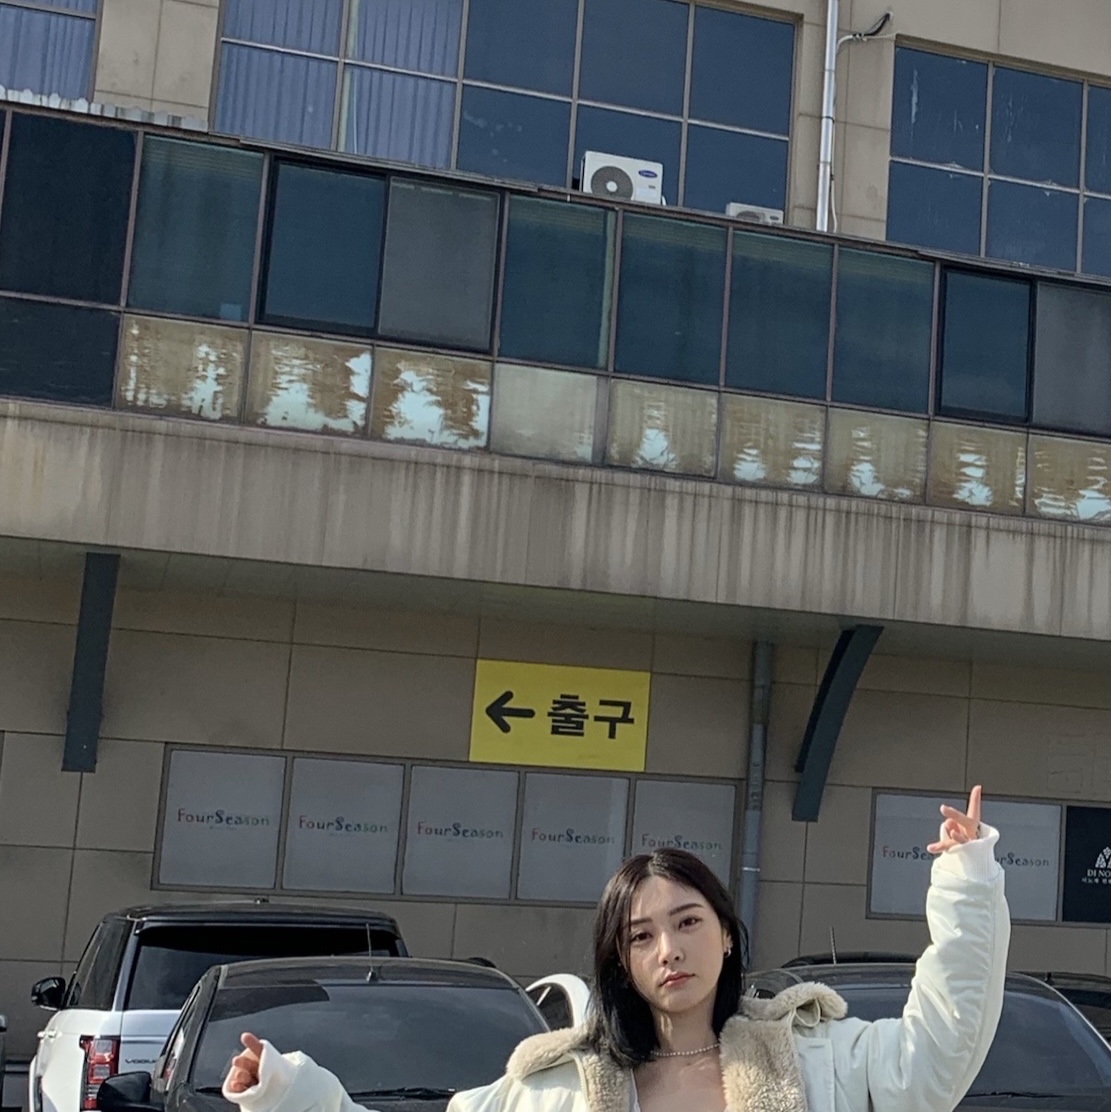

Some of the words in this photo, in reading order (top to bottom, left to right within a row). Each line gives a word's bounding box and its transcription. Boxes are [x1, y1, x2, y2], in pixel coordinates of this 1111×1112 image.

[547, 694, 635, 739] 출구
[177, 808, 270, 827] FourSeason
[299, 814, 388, 833] FourSeason
[416, 821, 504, 840] FourSeason
[531, 827, 616, 845] FourSeason
[1087, 869, 1097, 877] DI
